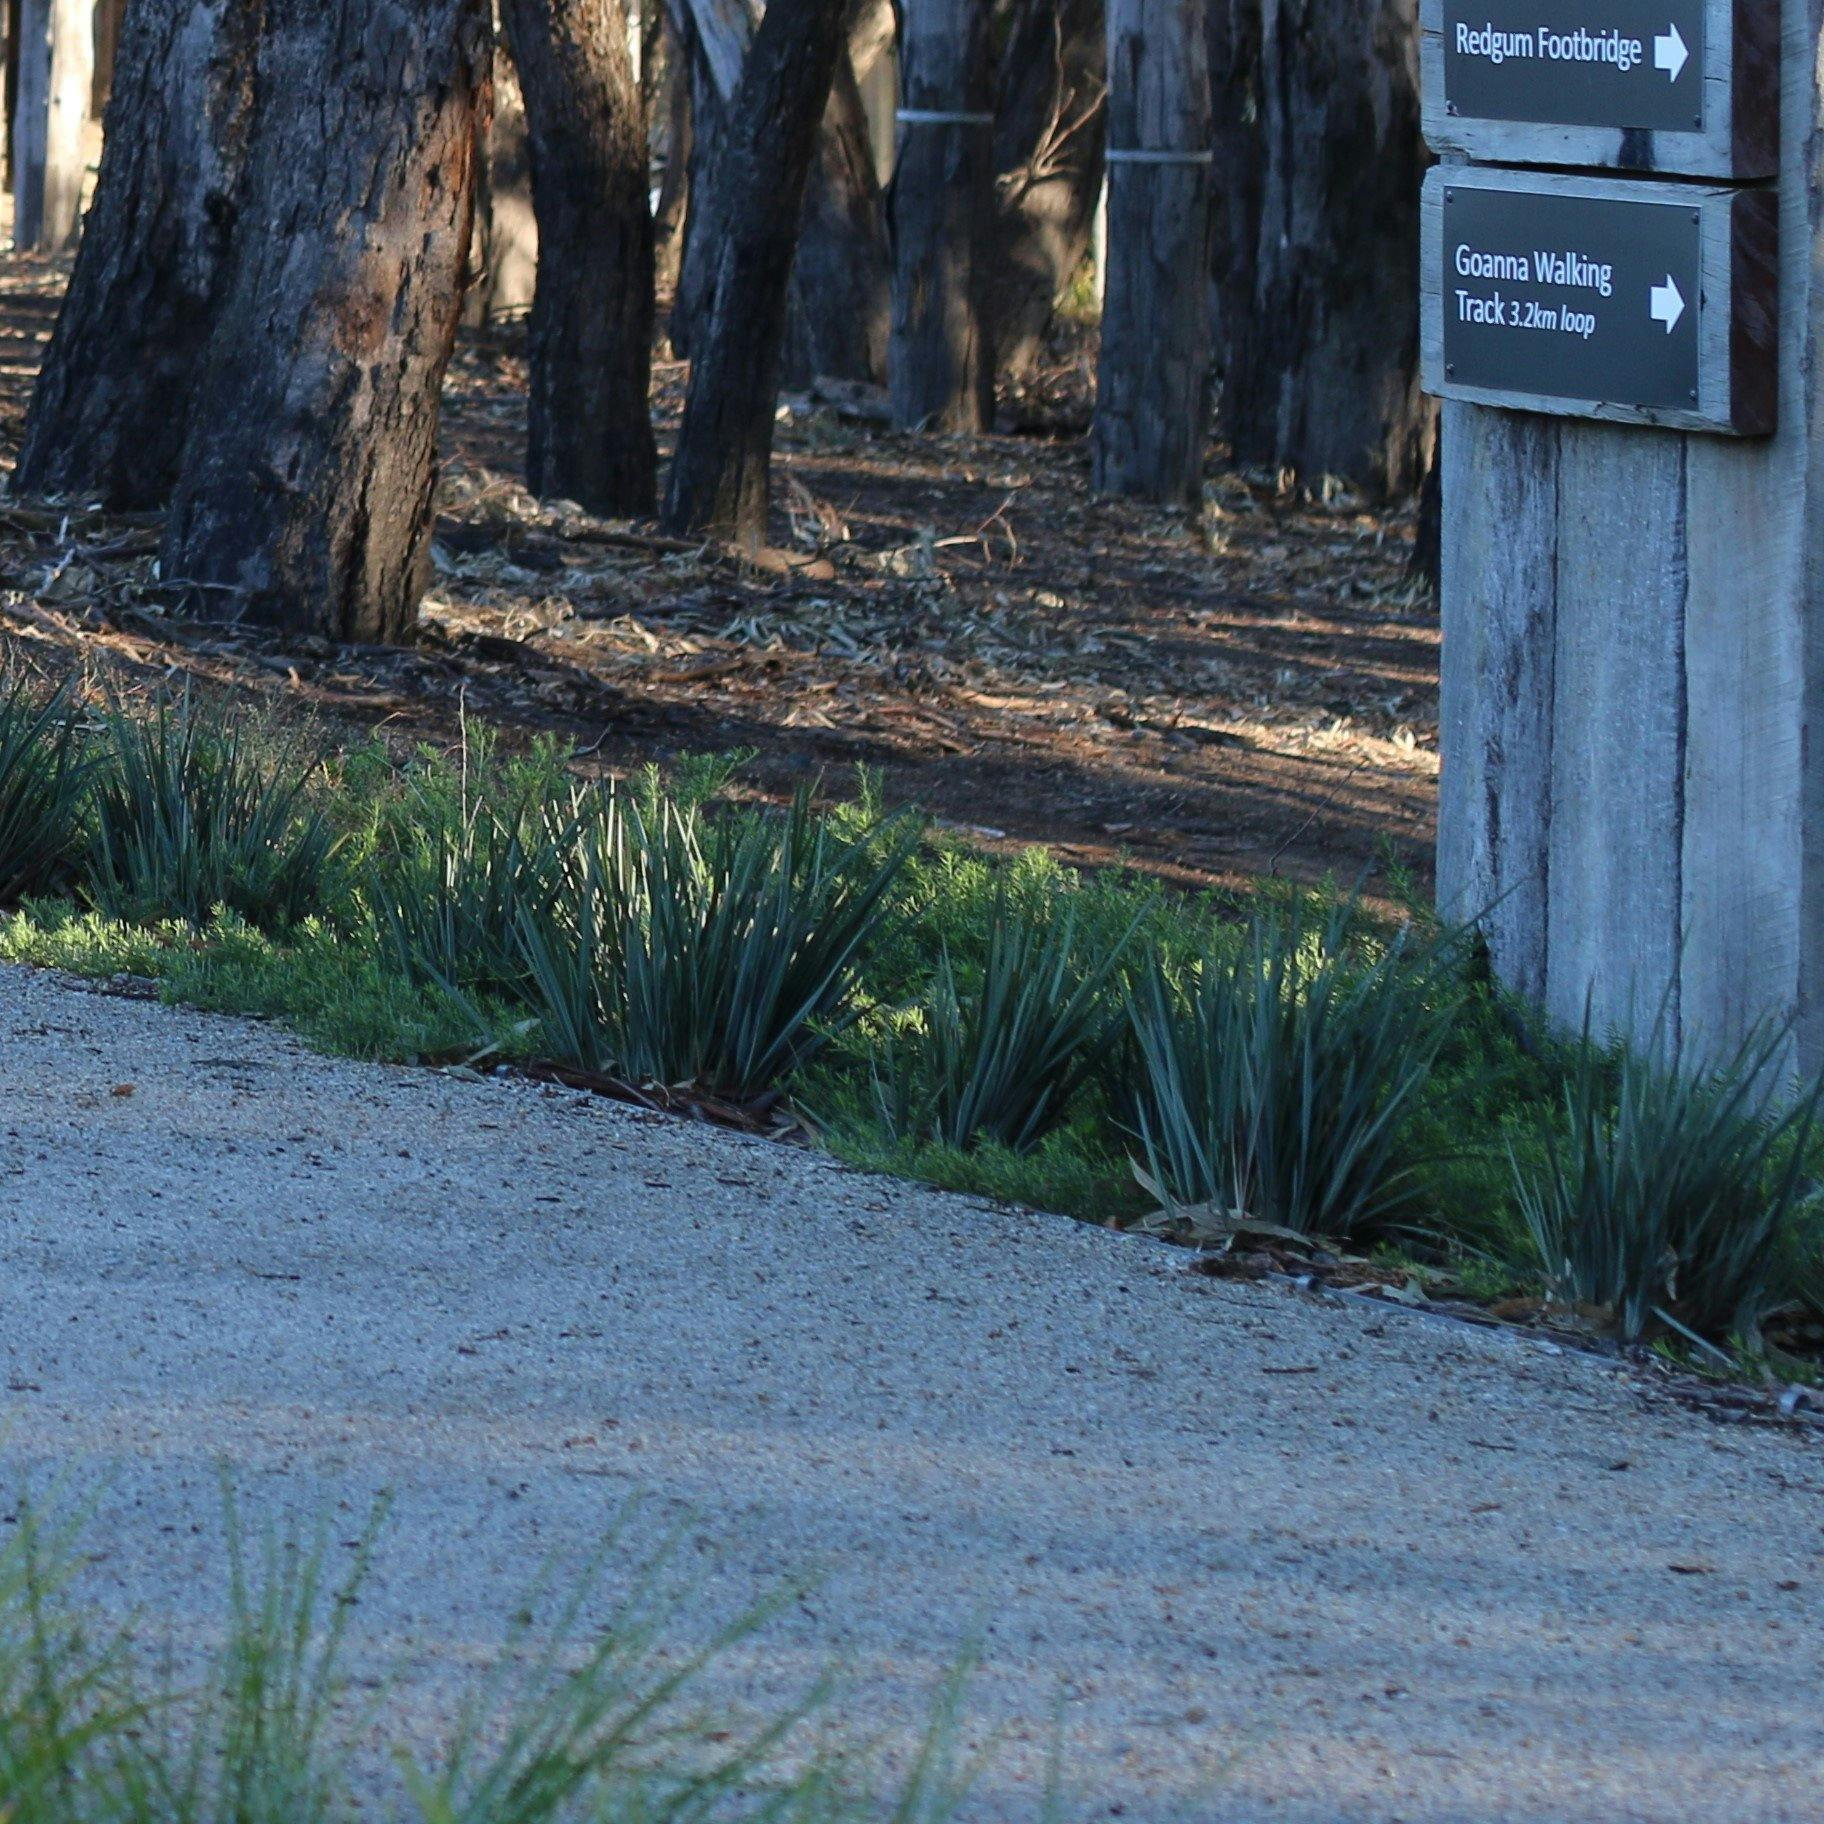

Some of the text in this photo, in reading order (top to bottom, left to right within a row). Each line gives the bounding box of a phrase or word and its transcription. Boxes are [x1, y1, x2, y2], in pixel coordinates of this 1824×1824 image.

[1456, 22, 1642, 71] Redgum Footbridge
[1455, 244, 1612, 297] Goanna Walking
[1455, 289, 1595, 340] Track 3.2km loop
